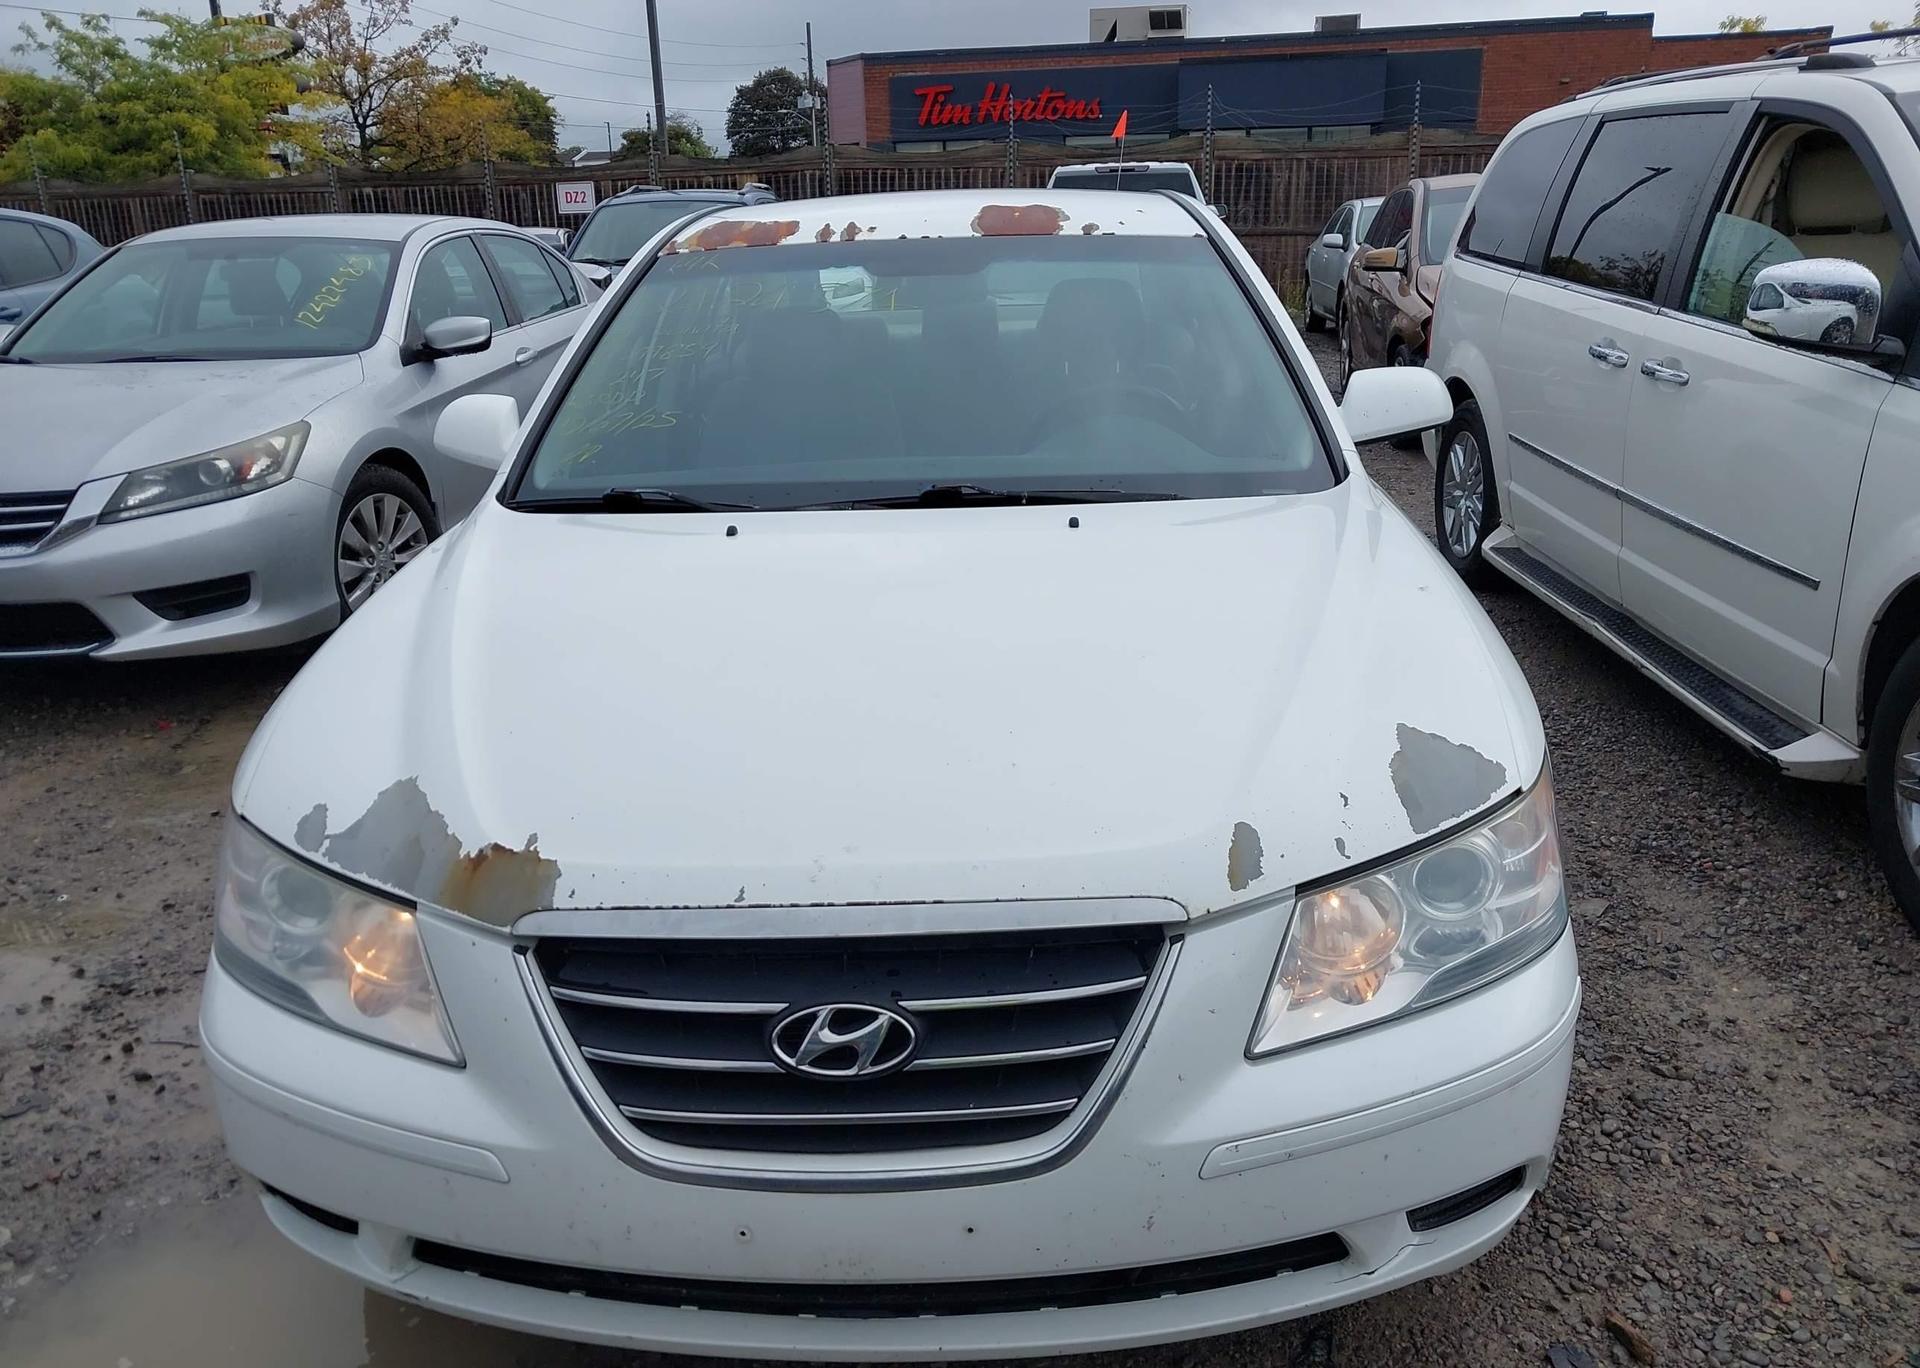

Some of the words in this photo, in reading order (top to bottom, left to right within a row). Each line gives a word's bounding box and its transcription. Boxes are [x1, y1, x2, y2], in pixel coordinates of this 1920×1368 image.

[914, 85, 972, 127] Tim
[977, 81, 1100, 124] Hortons
[565, 191, 587, 204] DZ2
